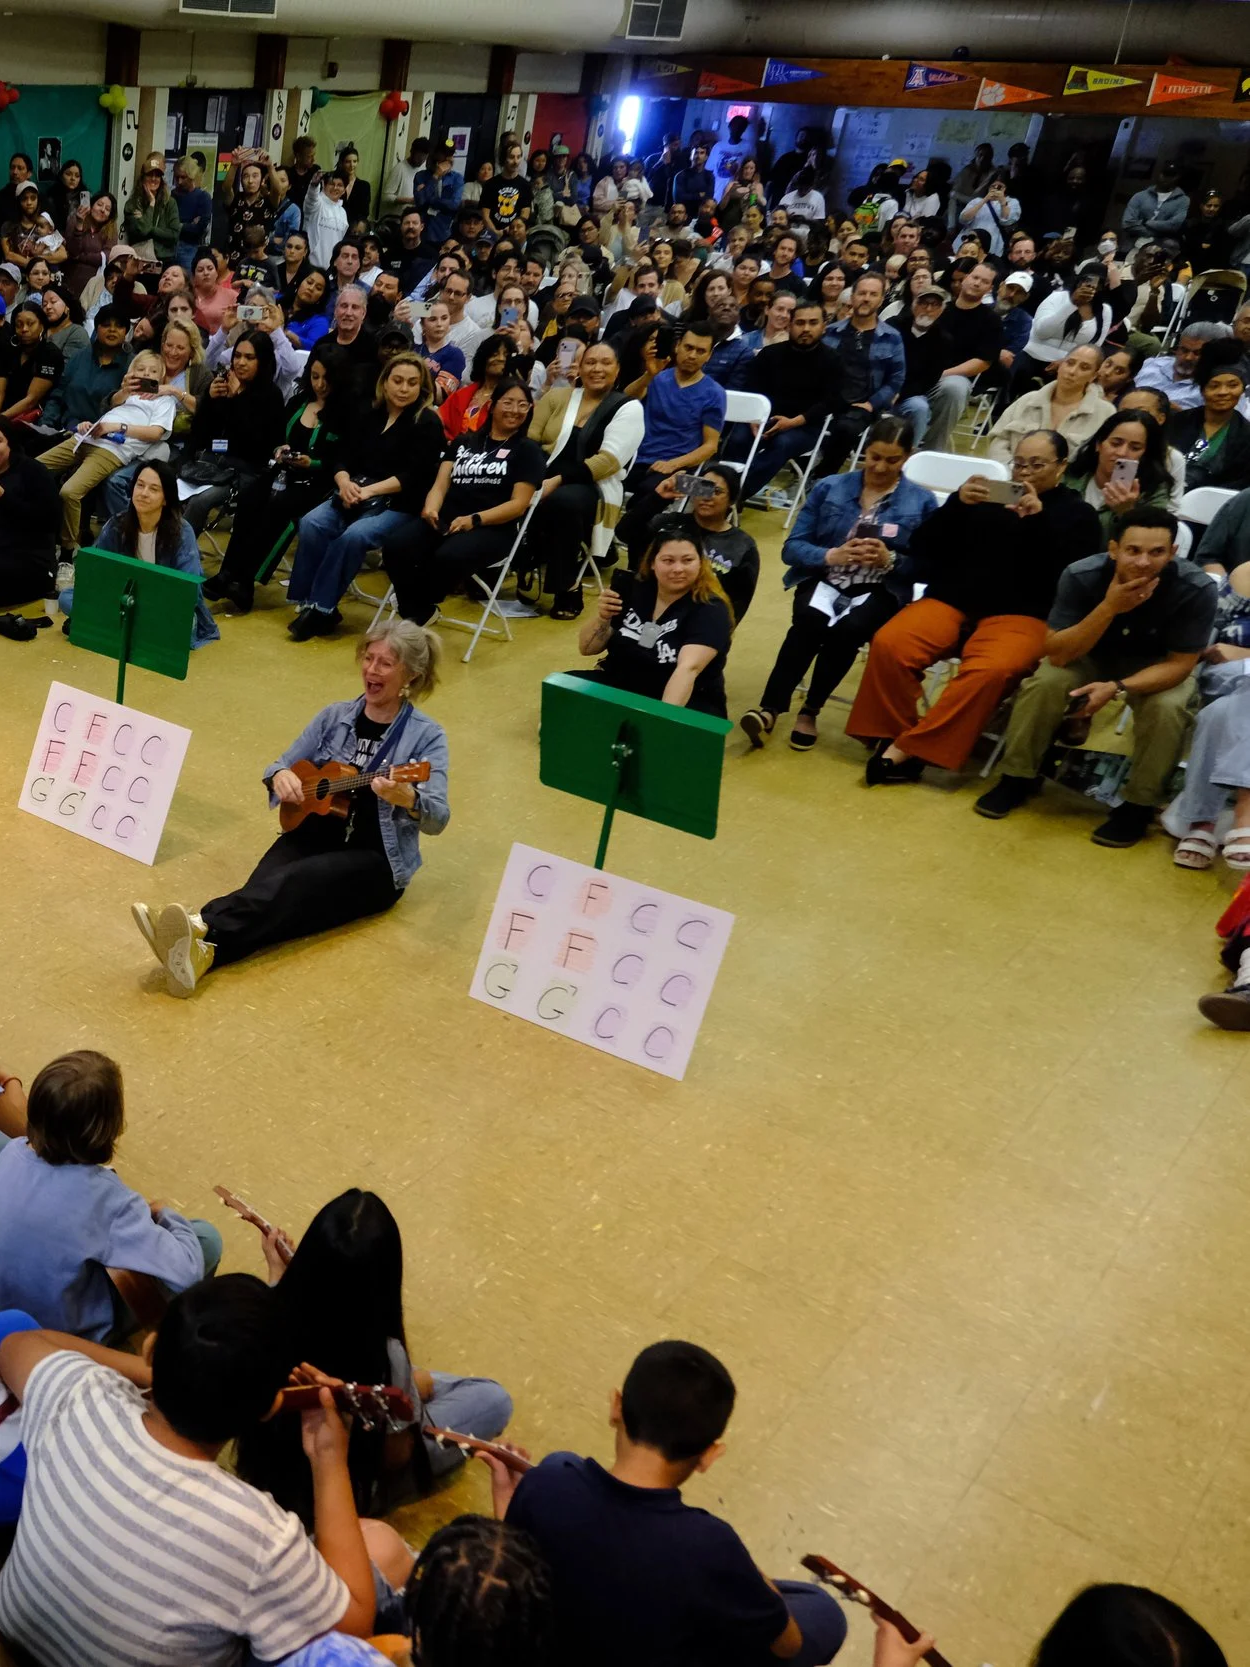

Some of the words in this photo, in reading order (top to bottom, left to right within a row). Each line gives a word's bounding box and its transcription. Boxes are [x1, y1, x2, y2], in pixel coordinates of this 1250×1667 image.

[54, 702, 72, 732] C
[87, 713, 107, 740] F
[113, 723, 132, 755] C
[141, 735, 162, 765] C
[43, 740, 66, 772] F
[74, 750, 96, 783] F
[101, 766, 121, 791] C
[128, 776, 149, 803] C
[91, 805, 106, 830] C
[115, 815, 136, 838] C
[527, 864, 552, 897] C
[582, 882, 608, 914] F
[631, 903, 658, 934] C
[676, 919, 709, 950] C
[504, 912, 535, 950] F
[563, 932, 594, 968] F
[612, 954, 644, 985] C
[660, 974, 692, 1007] C
[594, 1007, 621, 1039] C
[644, 1026, 674, 1058] C
